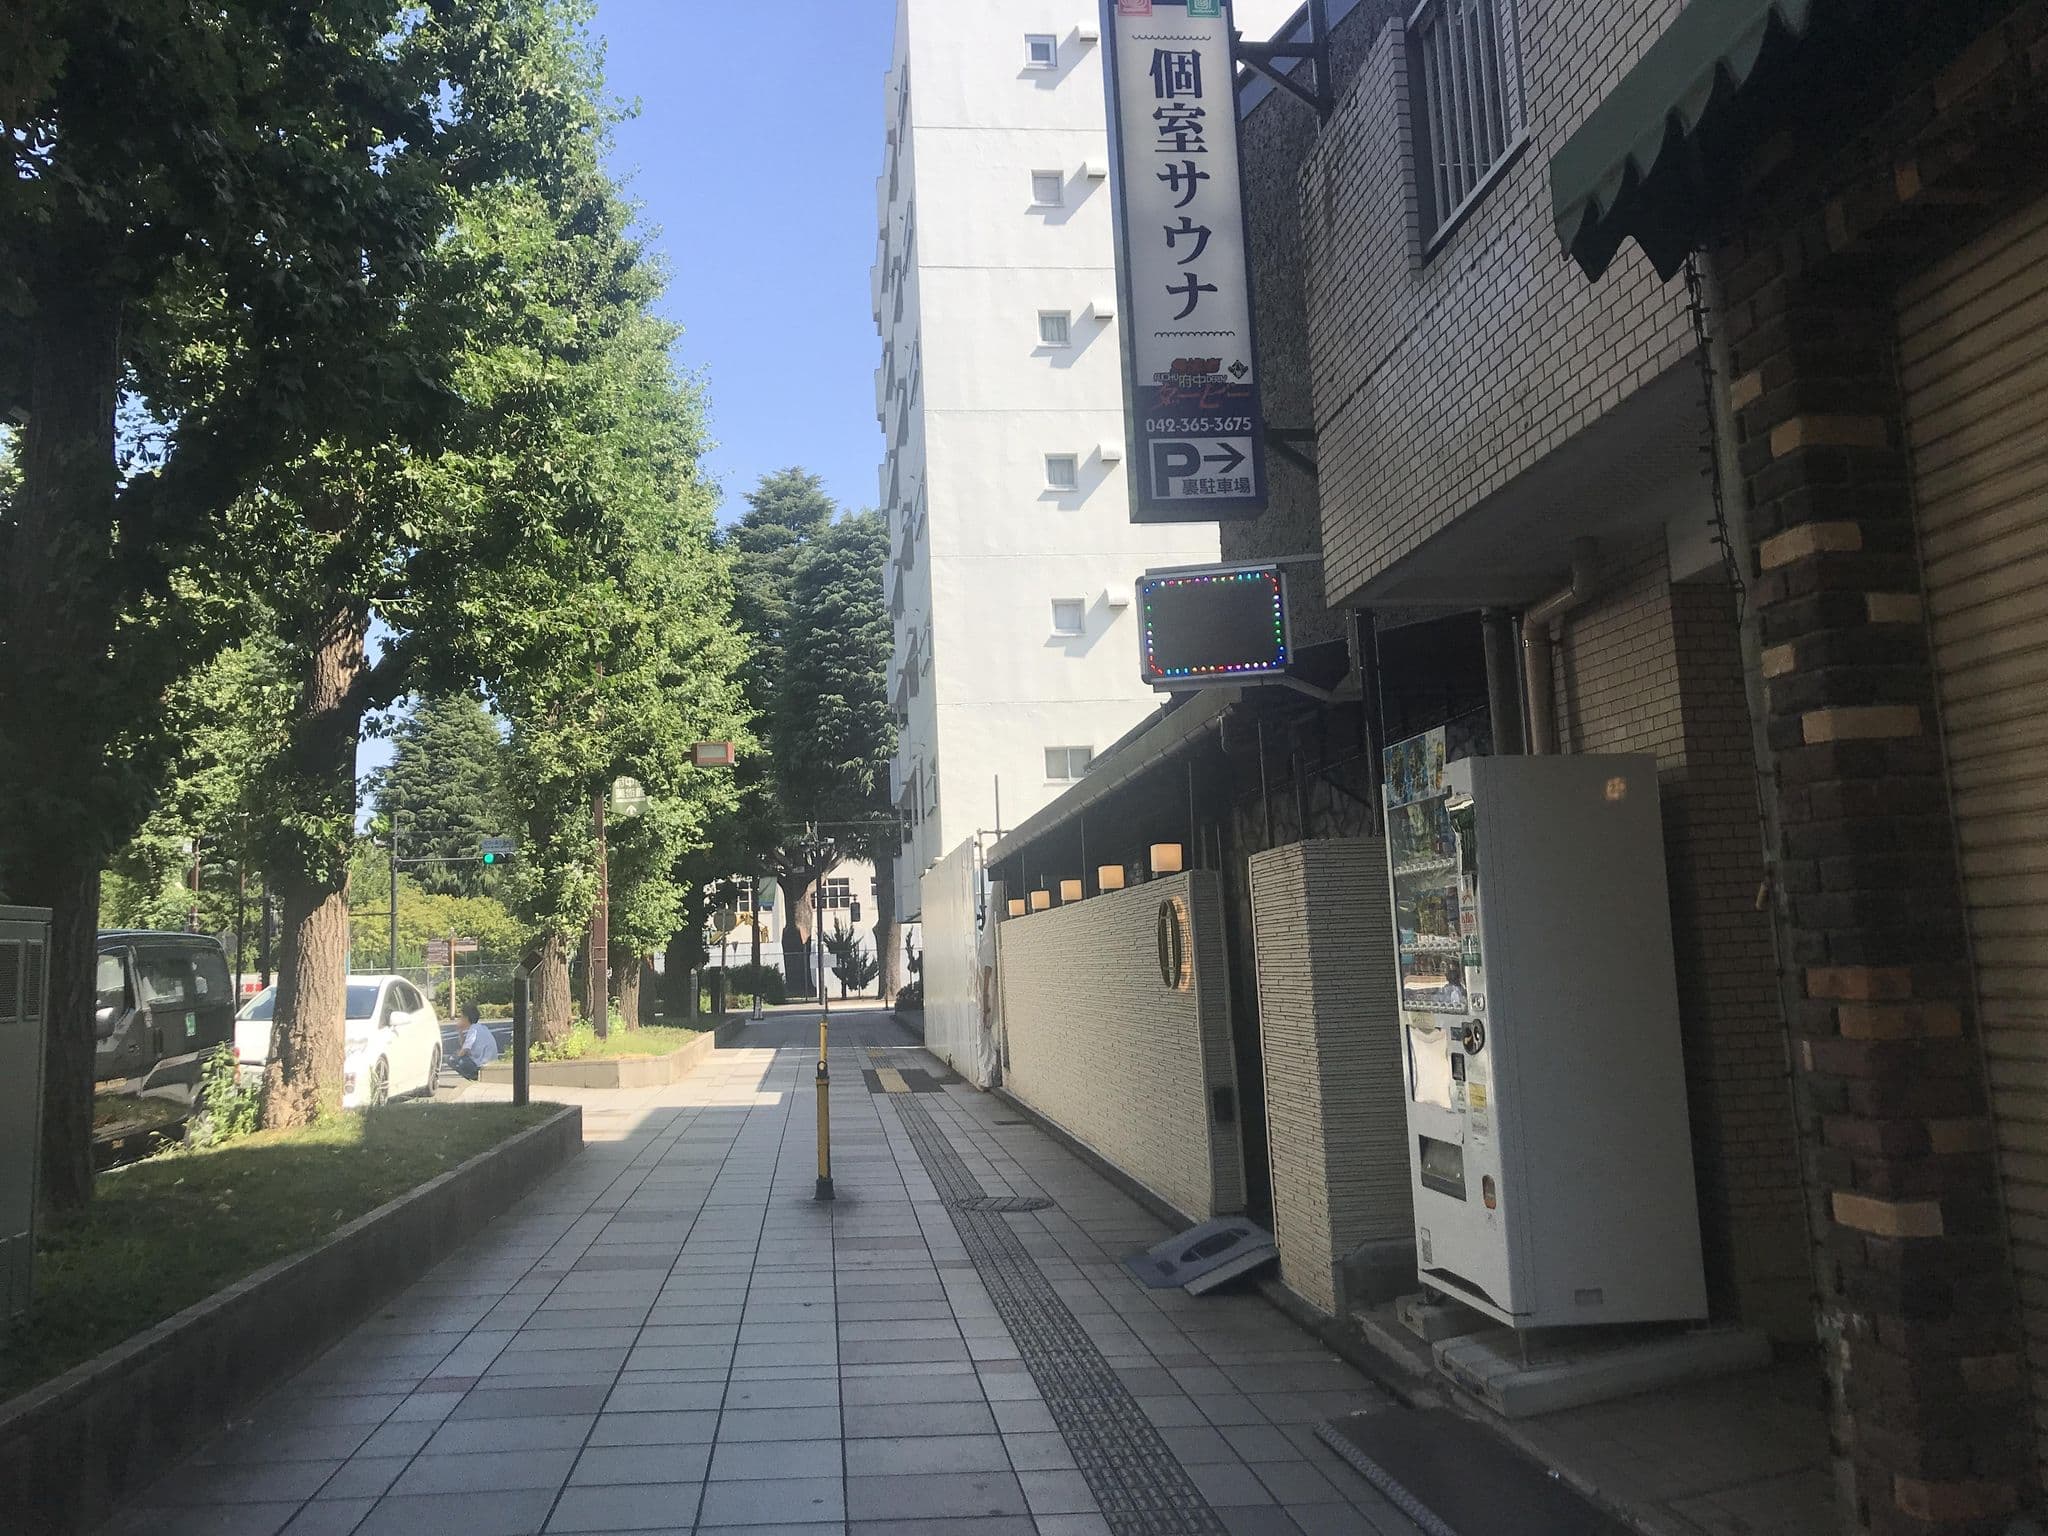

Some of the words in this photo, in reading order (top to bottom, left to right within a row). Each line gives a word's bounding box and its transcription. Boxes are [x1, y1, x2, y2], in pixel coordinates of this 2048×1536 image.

[1149, 47, 1218, 321] 個室サウナ
[1179, 373, 1207, 388] 府中
[1145, 416, 1252, 433] 042-365-3675
[1153, 442, 1201, 497] P
[1182, 477, 1251, 496] 裏駐車場
